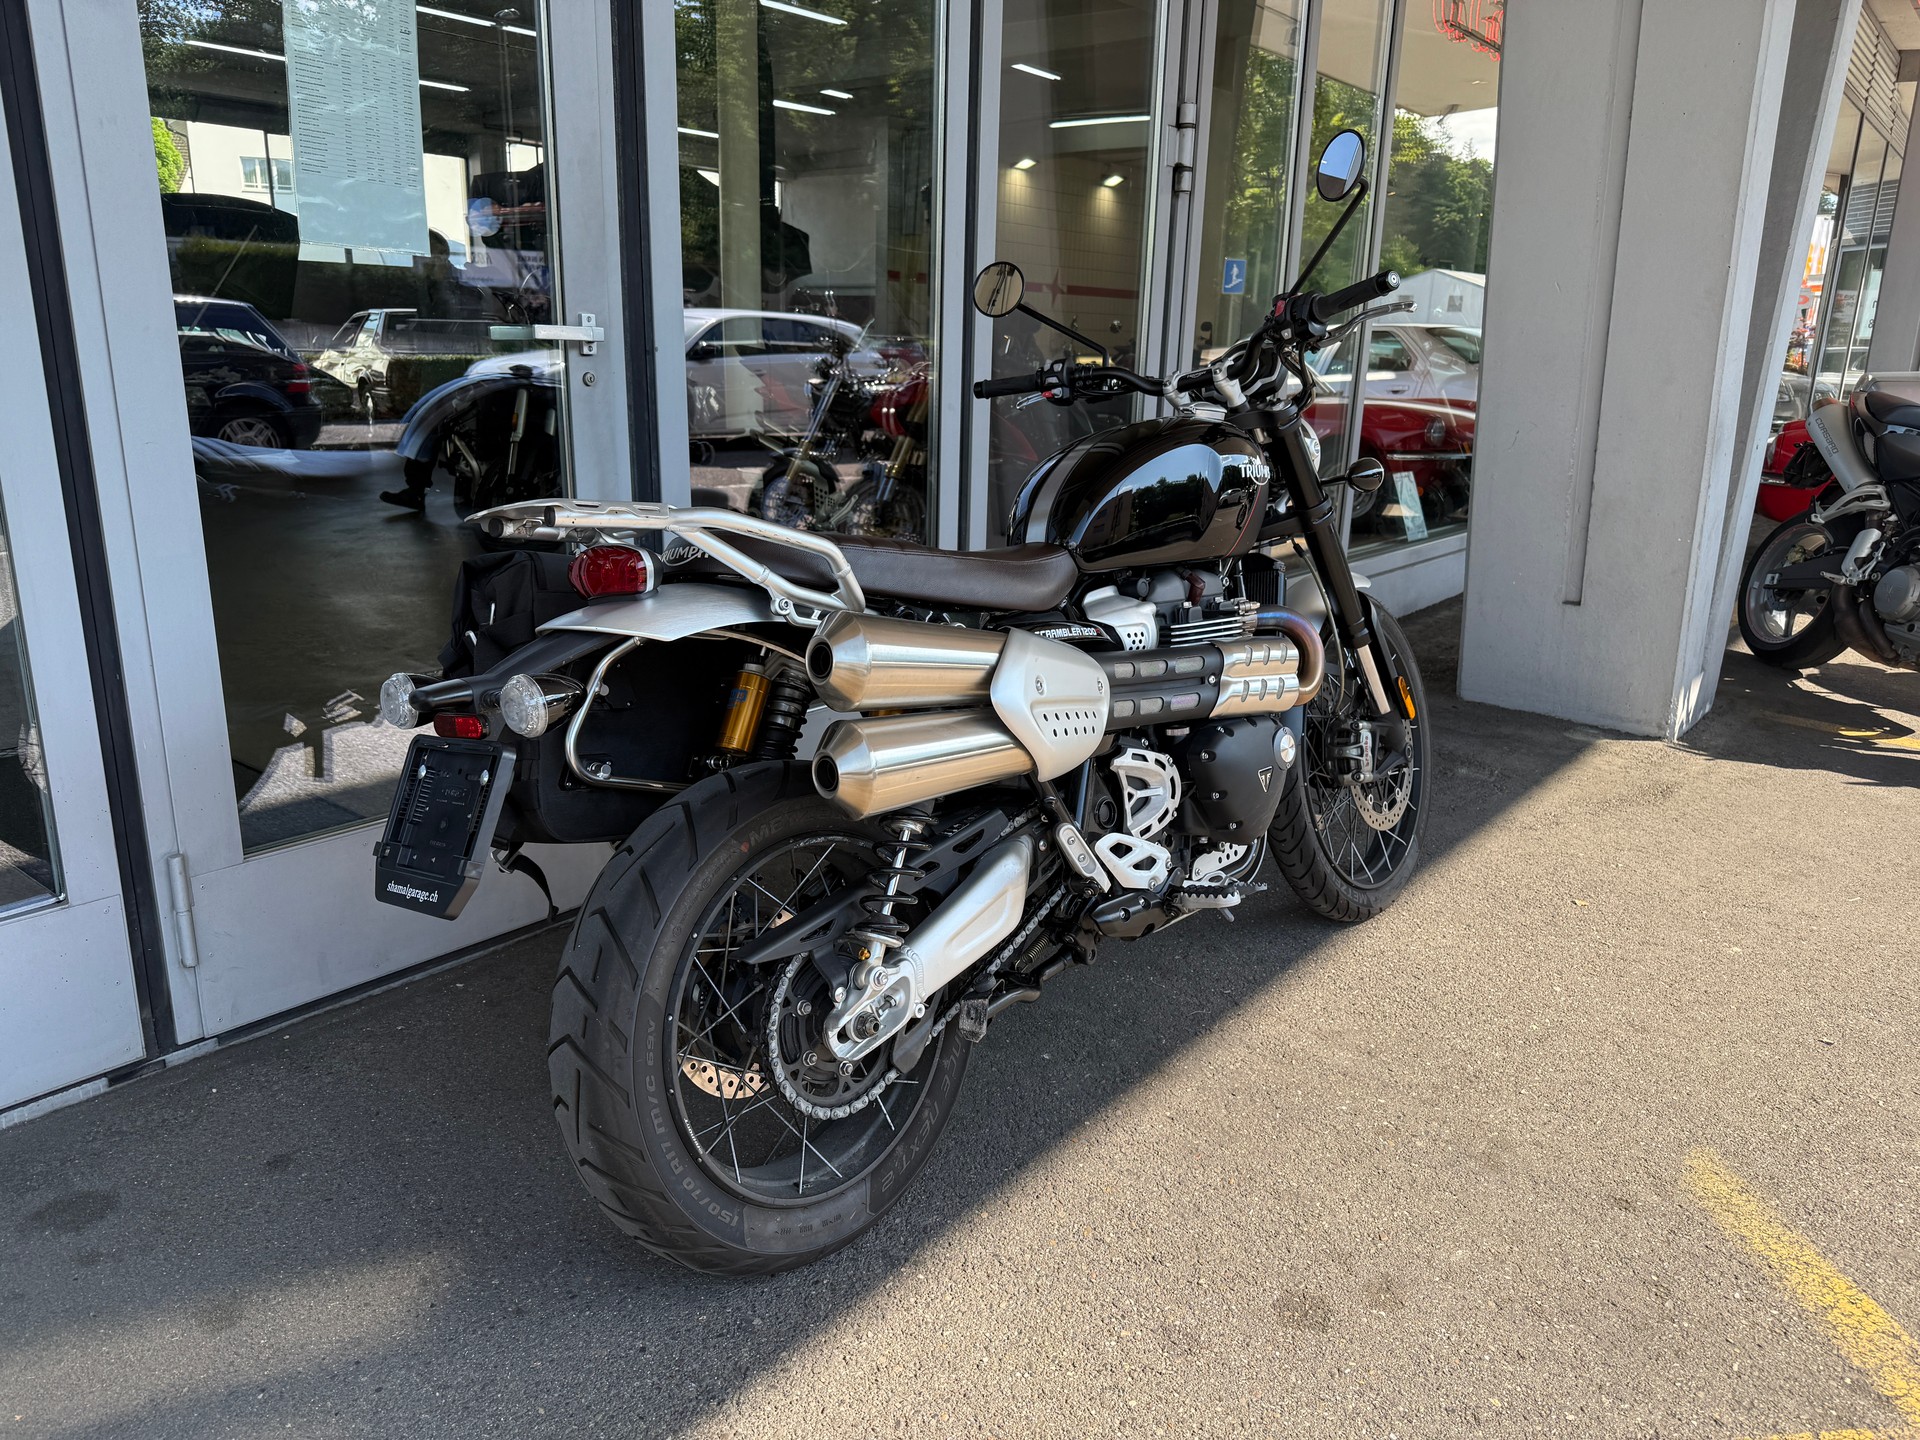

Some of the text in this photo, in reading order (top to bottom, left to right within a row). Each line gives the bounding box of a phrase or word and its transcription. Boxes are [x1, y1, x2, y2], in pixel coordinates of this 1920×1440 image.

[1081, 627, 1097, 636] 1200
[386, 880, 439, 903] shamalgarage.ch
[681, 1176, 740, 1227] 150/70
